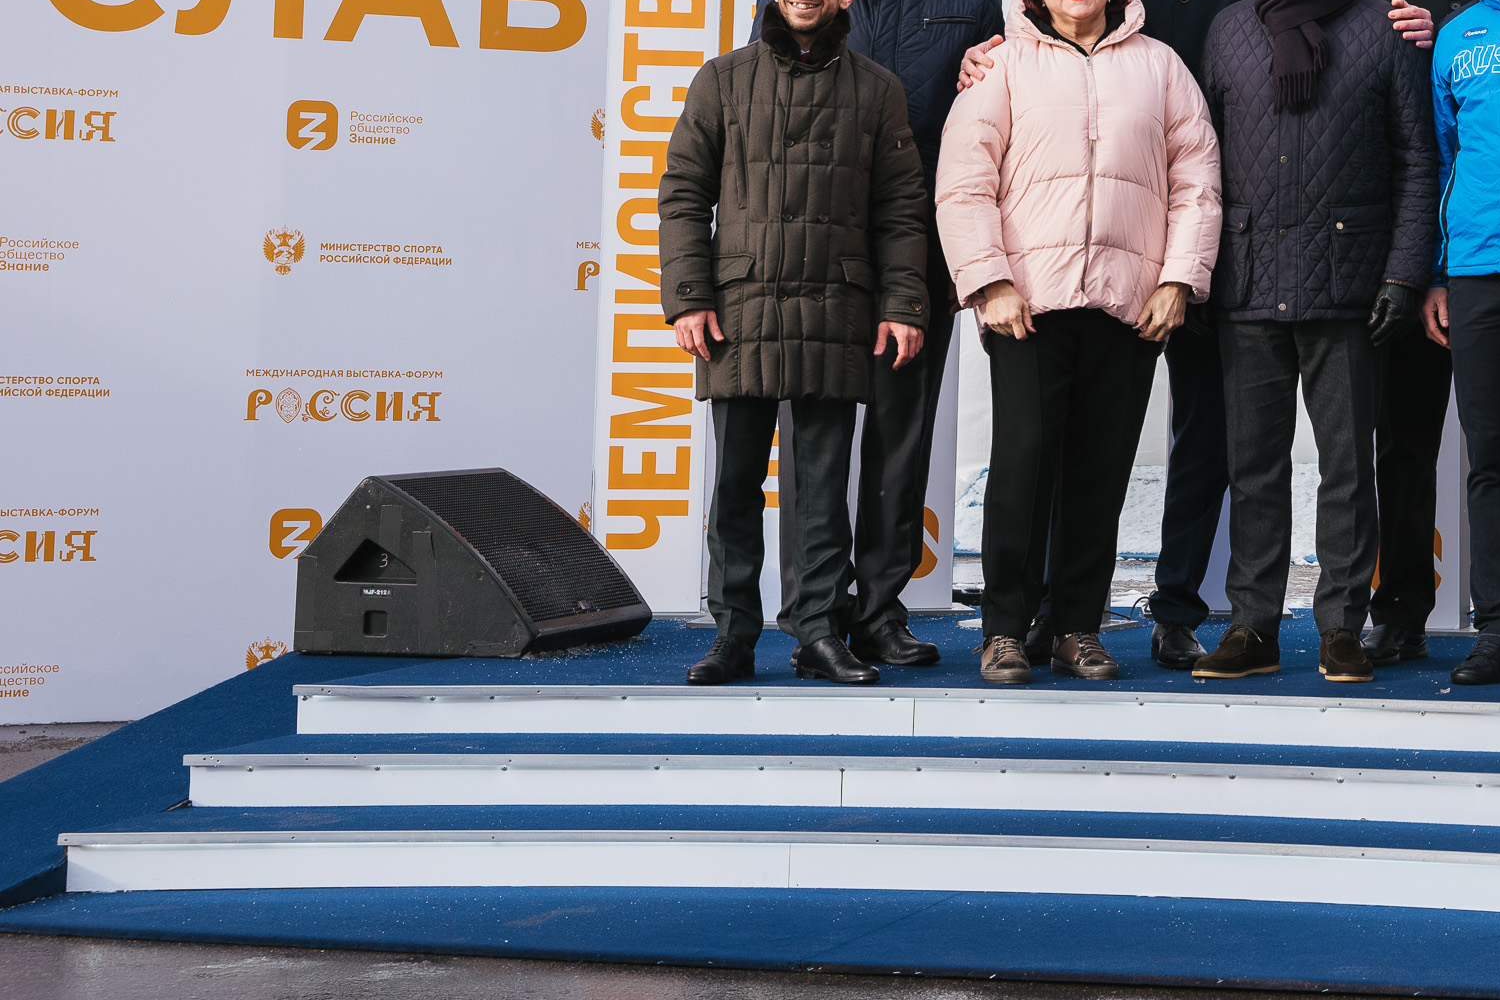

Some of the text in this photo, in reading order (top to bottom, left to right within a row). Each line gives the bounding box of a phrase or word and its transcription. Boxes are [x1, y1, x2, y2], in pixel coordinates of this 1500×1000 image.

[13, 85, 119, 98] ВЫСТАВКА-ФОРУМ
[350, 110, 424, 125] Российское
[349, 122, 411, 135] общество
[348, 132, 397, 145] Знание
[0, 236, 80, 250] Российское
[320, 242, 444, 256] МИНИСТЕРСТВО СПОРТА
[0, 248, 65, 261] общество
[319, 254, 453, 267] РОССИЙСКОЙ ФЕДЕРАЦИИ
[0, 259, 50, 272] Знание
[56, 376, 100, 385] СПОРТА
[245, 368, 444, 380] МЕЖДУНАРОДНАЯ ВЫСТАВКА-ФОРУМ
[44, 388, 111, 399] ФЕДЕРАЦИИ
